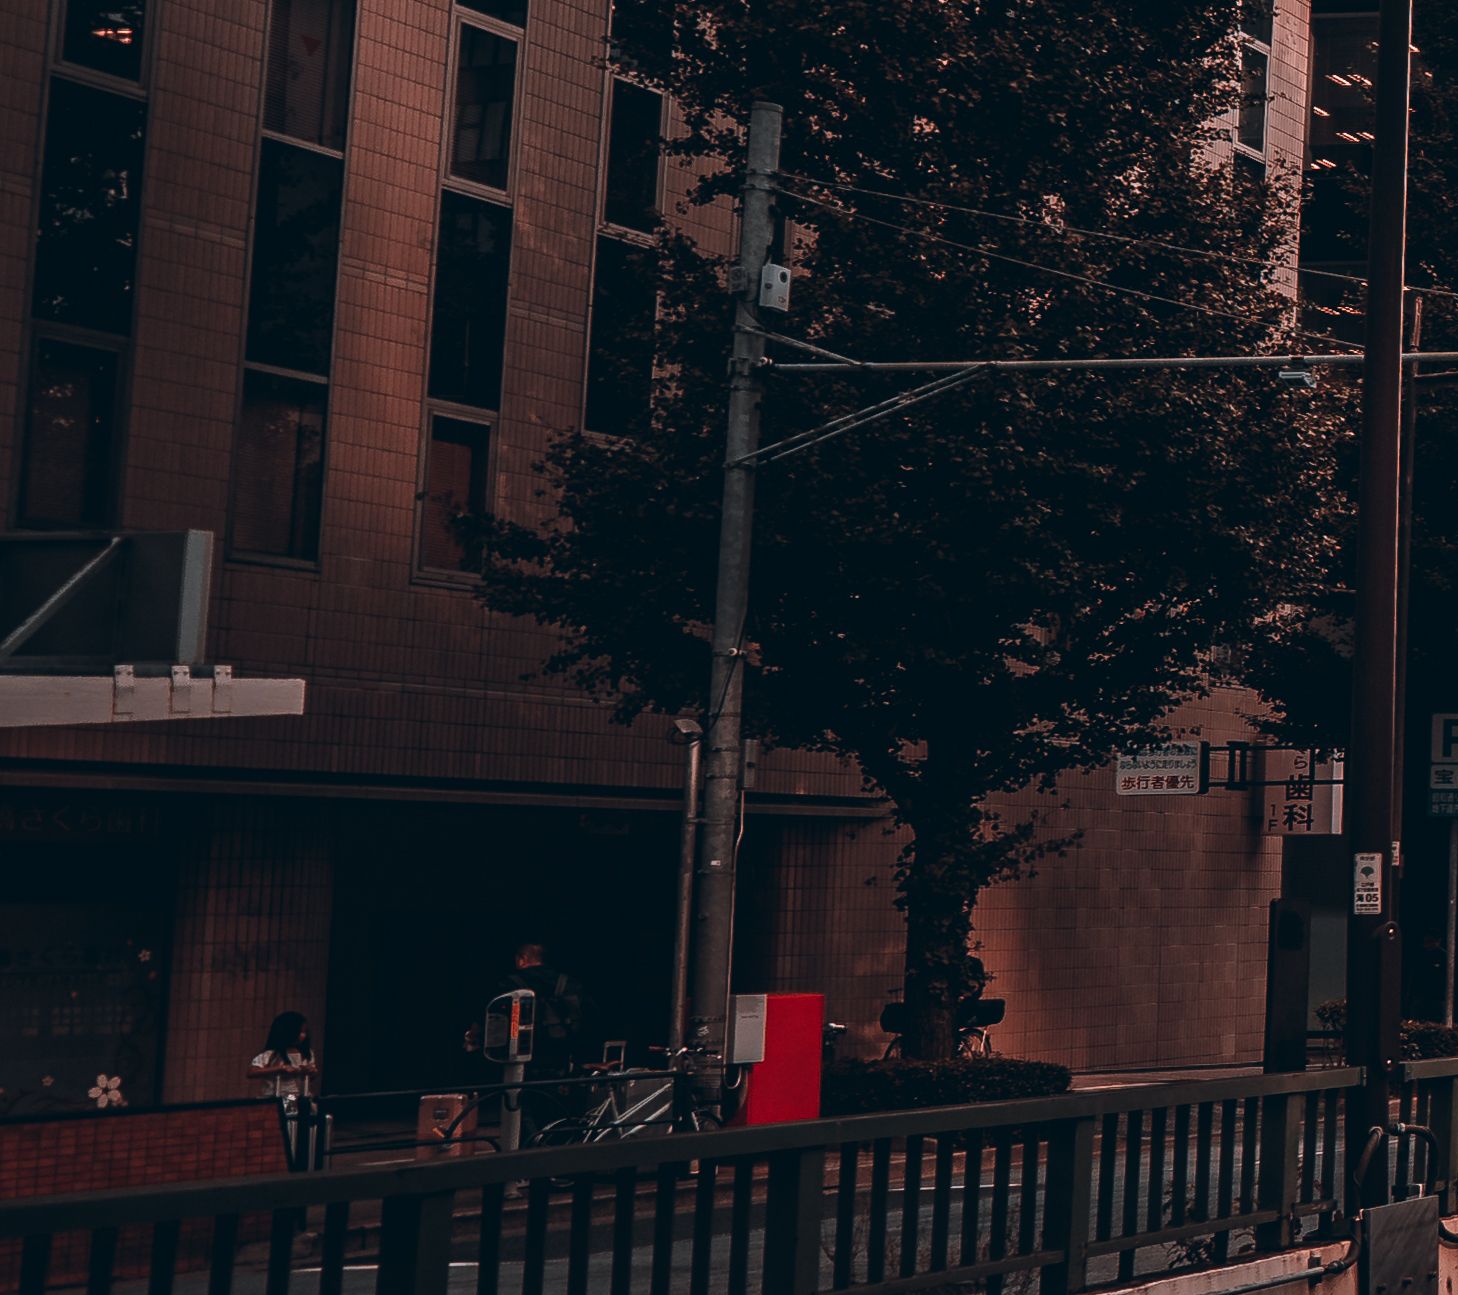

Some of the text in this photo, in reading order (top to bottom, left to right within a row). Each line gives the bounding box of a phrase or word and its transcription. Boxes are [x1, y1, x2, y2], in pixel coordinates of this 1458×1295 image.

[1121, 774, 1195, 790] 歩行者優先
